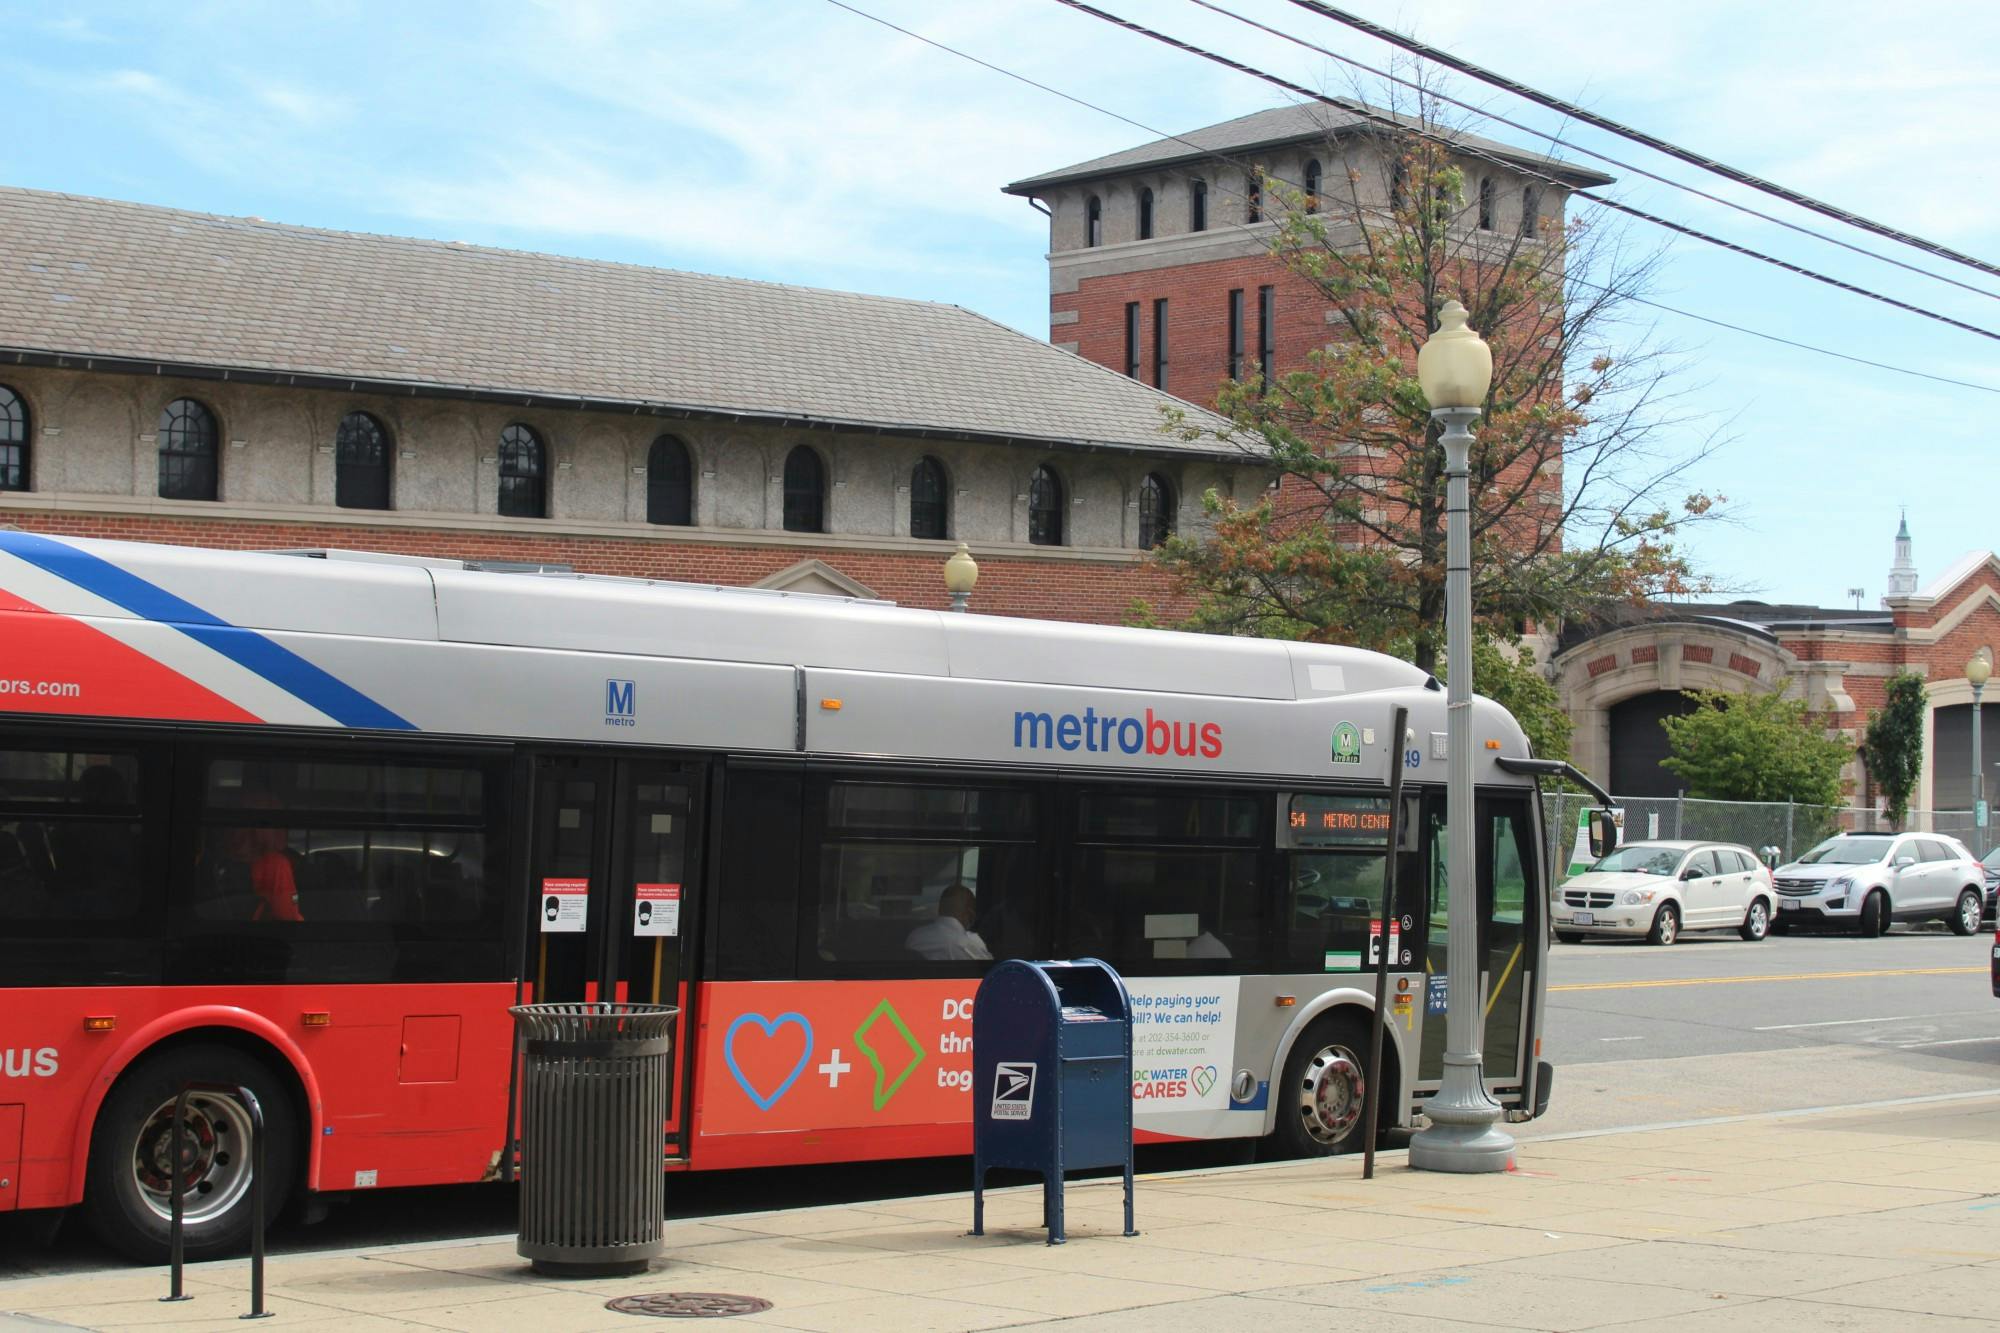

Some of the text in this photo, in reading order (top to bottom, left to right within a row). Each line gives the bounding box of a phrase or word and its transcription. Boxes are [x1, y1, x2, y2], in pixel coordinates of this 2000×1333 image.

[608, 681, 634, 715] M
[605, 717, 635, 727] metro
[1013, 706, 1223, 758] metrobus
[1334, 755, 1358, 763] HYBRID
[1290, 812, 1306, 827] 54
[1323, 813, 1357, 828] METRO
[1130, 994, 1220, 1008] help paying your
[1154, 1013, 1171, 1024] We
[1174, 1014, 1193, 1024] can
[1195, 1011, 1222, 1025] help!
[1133, 1068, 1188, 1081] DC WATER
[1132, 1081, 1187, 1099] CARES
